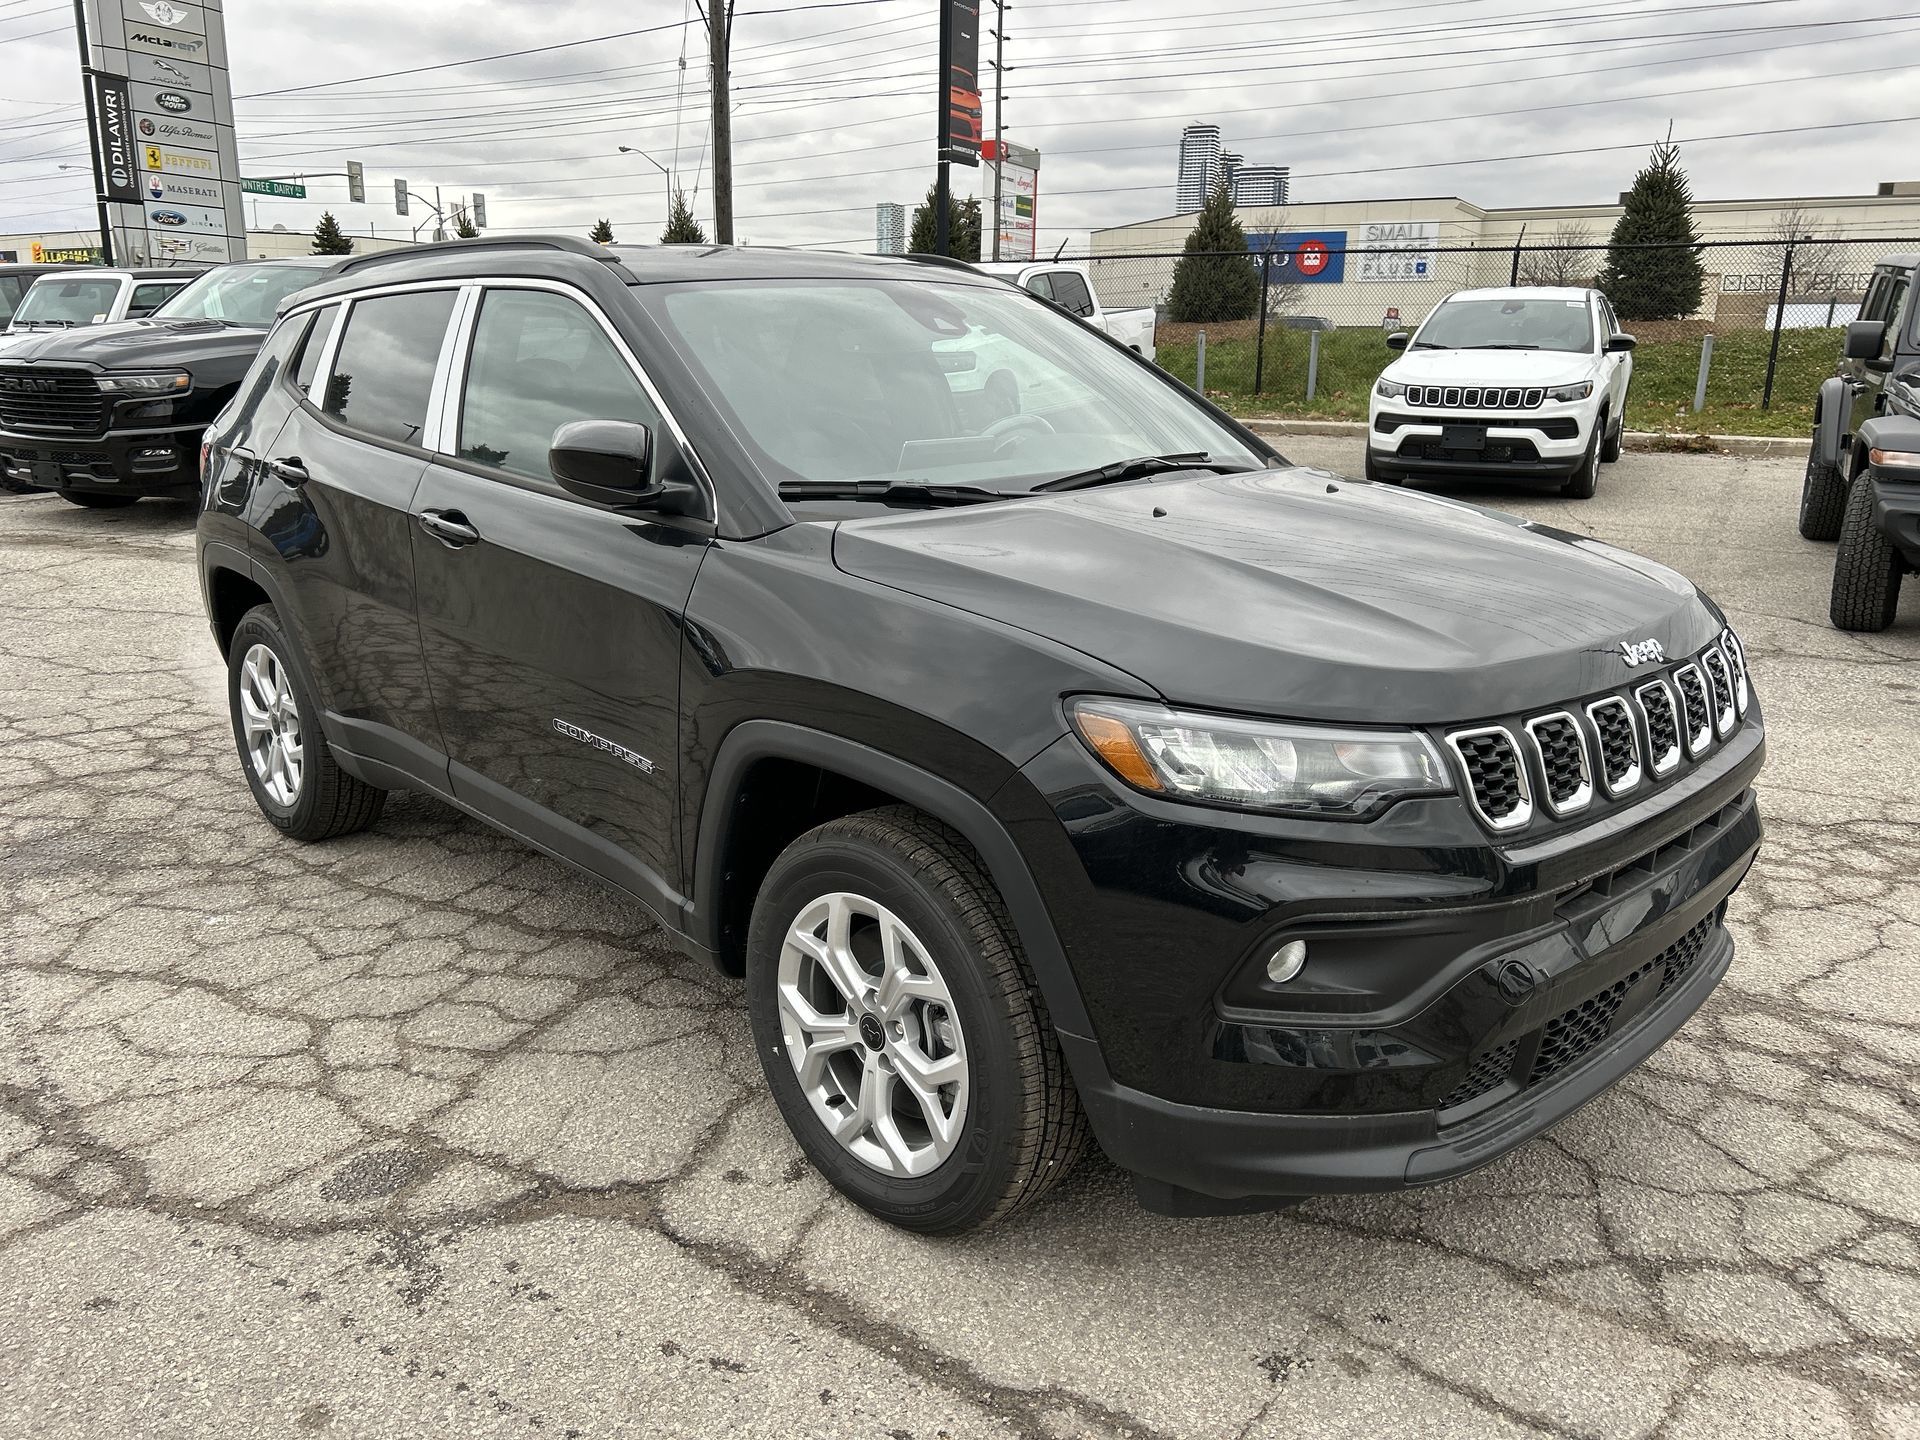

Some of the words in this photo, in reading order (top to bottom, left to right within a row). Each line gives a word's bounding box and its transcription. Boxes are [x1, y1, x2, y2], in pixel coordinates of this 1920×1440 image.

[150, 76, 192, 88] JAGUAR
[161, 94, 181, 103] LAND
[164, 101, 187, 110] ROVER
[104, 89, 124, 166] DILAWRI
[159, 124, 181, 137] Alfa
[181, 126, 213, 140] Romeo
[166, 184, 218, 198] MASERATI
[273, 183, 294, 195] DAIRY
[157, 211, 180, 225] Ford
[1366, 223, 1429, 241] SMALL
[1241, 250, 1290, 267] MO
[4, 377, 58, 392] RAM
[1620, 637, 1664, 668] Jeep
[552, 717, 655, 775] COMPASS
